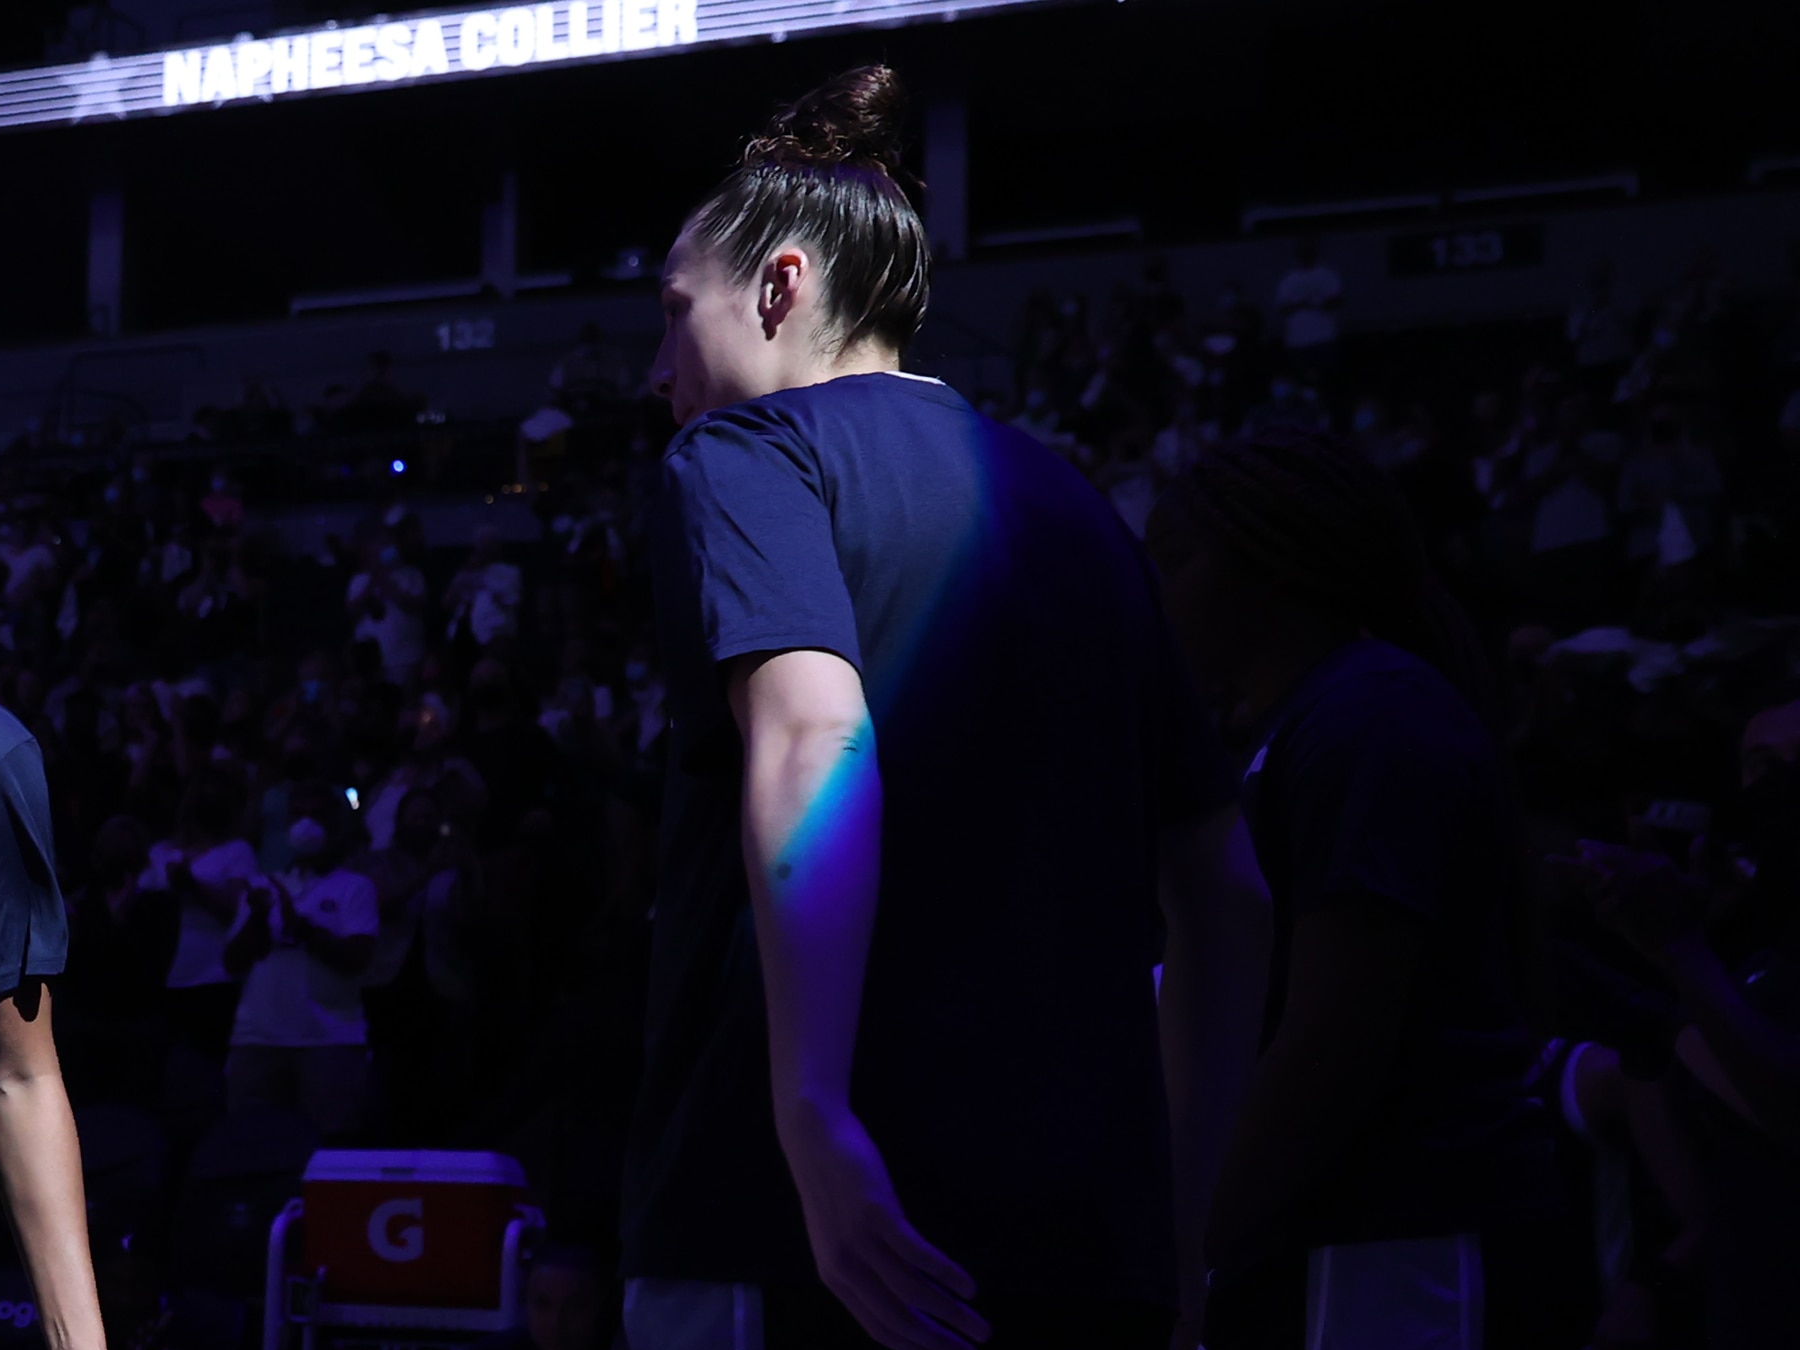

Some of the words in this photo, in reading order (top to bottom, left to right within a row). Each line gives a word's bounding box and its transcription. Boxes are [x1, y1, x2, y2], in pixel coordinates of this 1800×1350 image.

[163, 19, 449, 105] NAPHEESA
[460, 0, 698, 72] COLLIER
[365, 1195, 425, 1264] G
